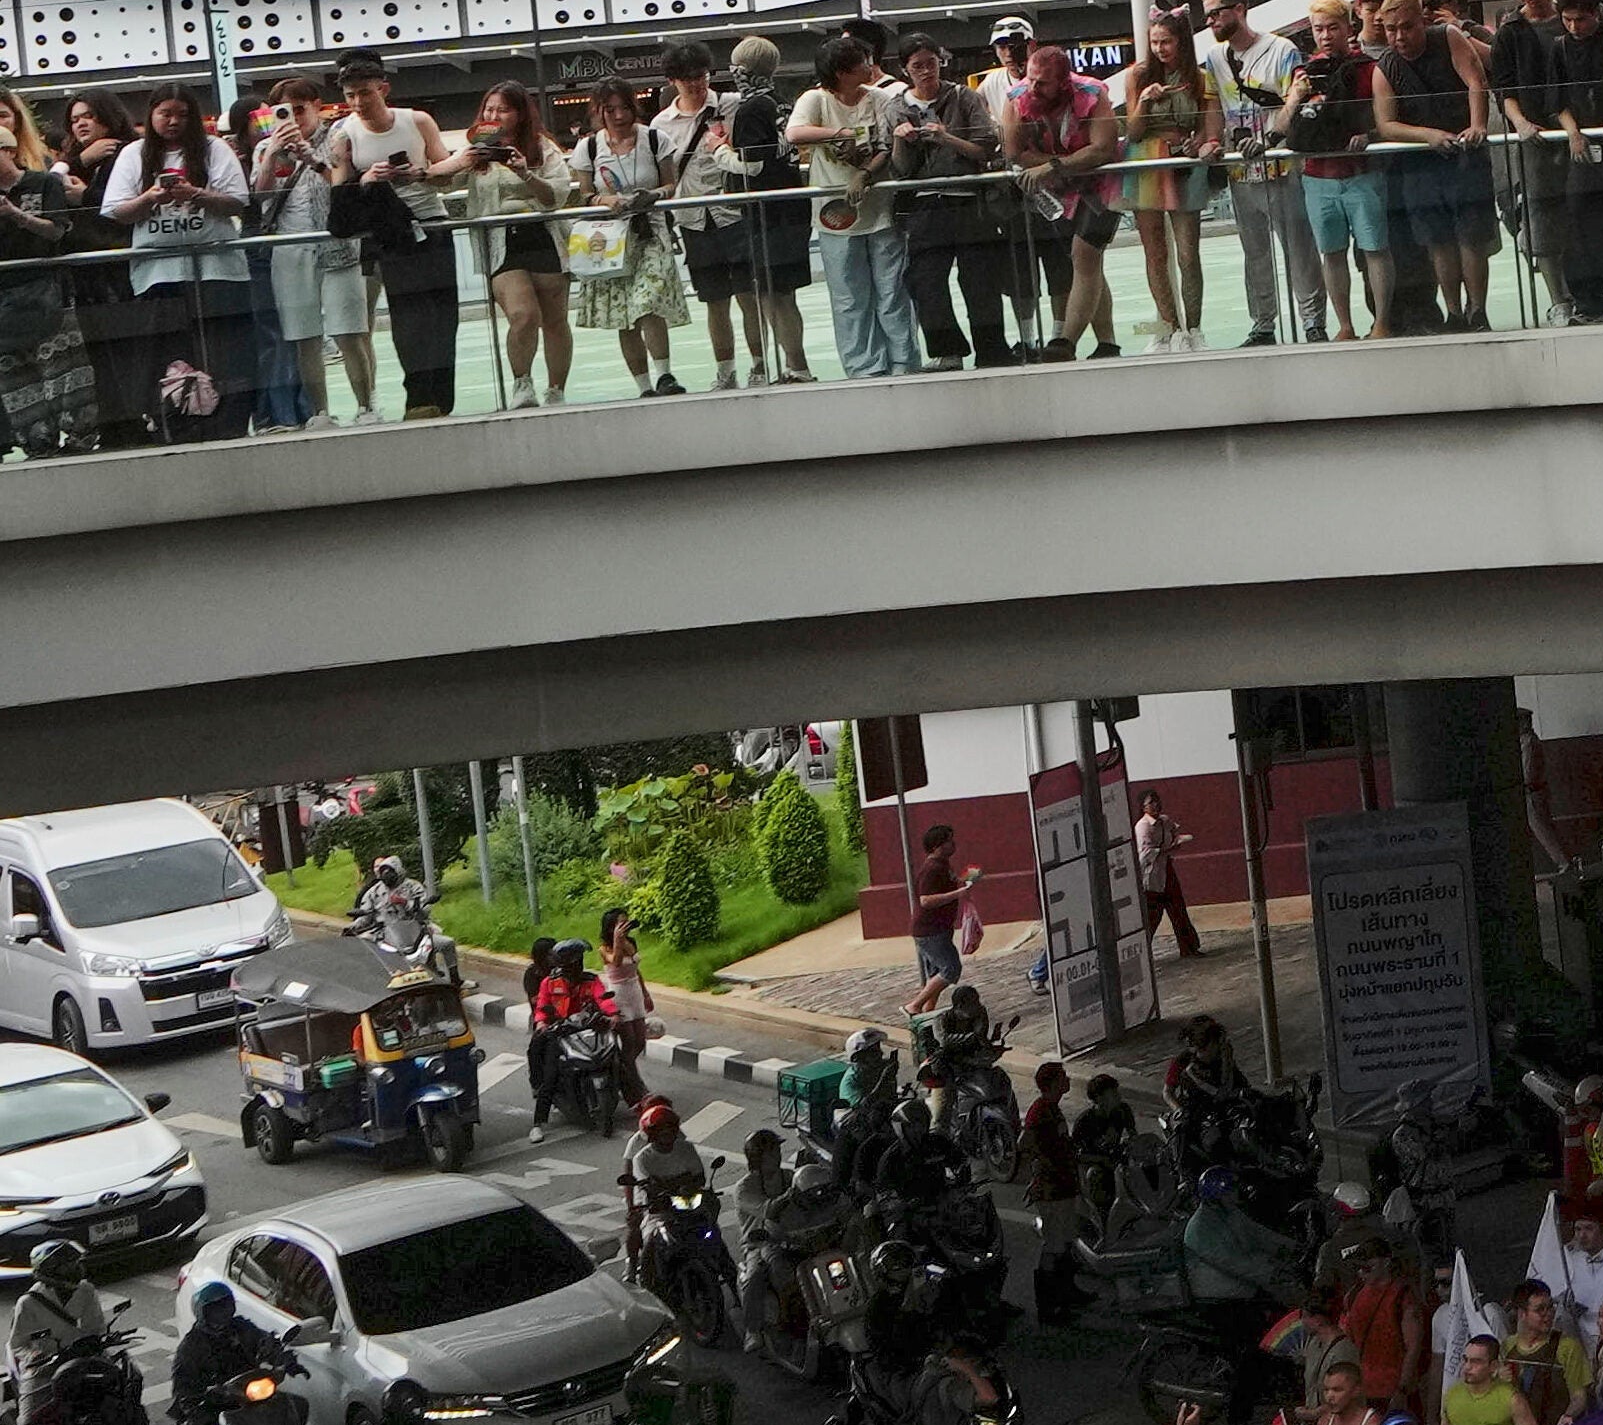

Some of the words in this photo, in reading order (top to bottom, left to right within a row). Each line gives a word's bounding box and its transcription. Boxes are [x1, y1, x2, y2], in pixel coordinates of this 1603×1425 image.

[560, 55, 616, 80] MBK
[614, 54, 666, 71] CENTE
[149, 216, 205, 234] DENG
[1327, 876, 1457, 912] โปรดหลีกเลี่ยง
[1361, 910, 1429, 933] เส้นทาง
[1451, 950, 1459, 966] 1
